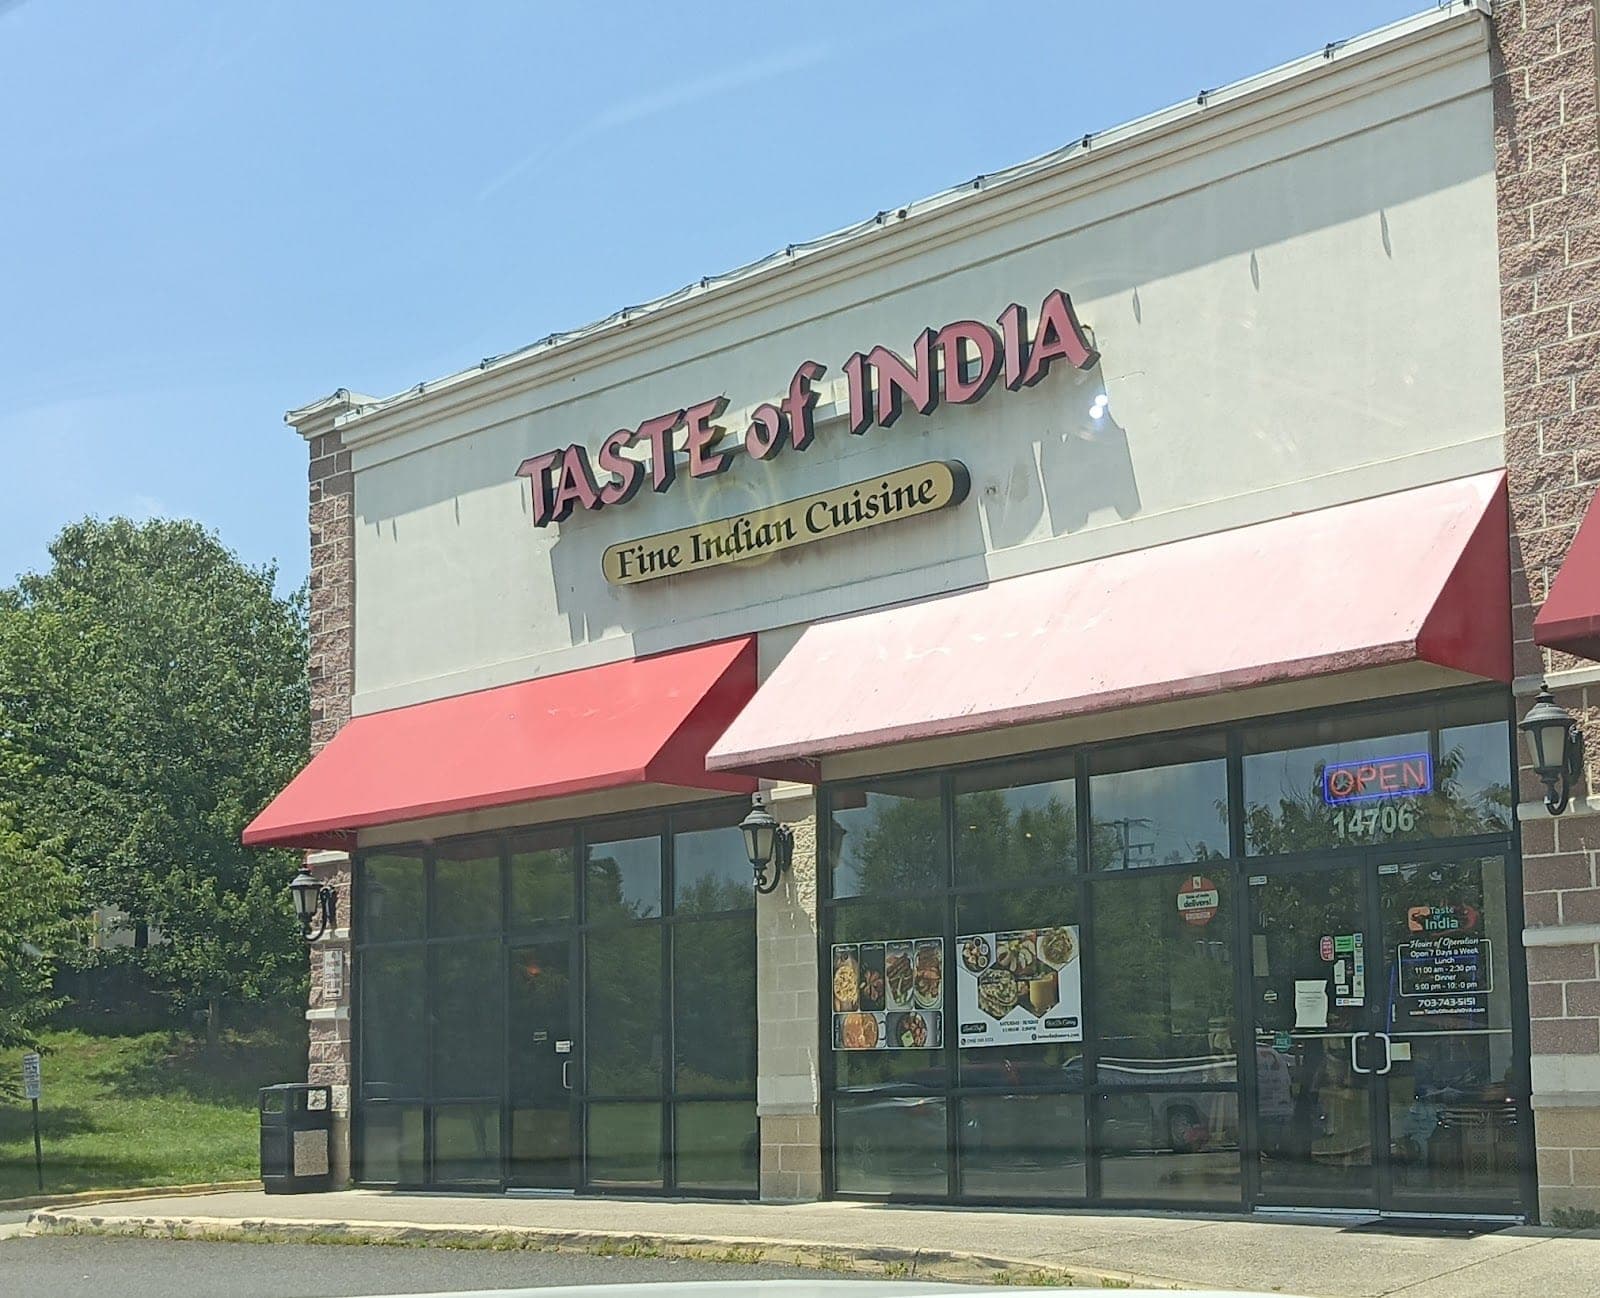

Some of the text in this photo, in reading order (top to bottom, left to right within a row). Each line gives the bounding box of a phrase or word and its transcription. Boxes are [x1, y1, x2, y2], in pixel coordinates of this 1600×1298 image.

[515, 289, 1101, 528] TASTE of INDIA
[617, 477, 938, 579] Fine Indian Cuisine
[1330, 759, 1427, 798] OPEN
[1333, 804, 1414, 838] 14706
[1430, 906, 1454, 914] Taste
[1425, 918, 1459, 930] India
[1409, 937, 1478, 949] Hours of Operation
[1410, 951, 1429, 959] Open
[1436, 949, 1452, 958] Days
[1434, 957, 1455, 965] Lunch
[1465, 965, 1477, 973] pm
[1431, 983, 1441, 991] pm
[1447, 981, 1465, 989] 10:0
[1466, 981, 1477, 989] pm
[1418, 998, 1476, 1008] 703-743-5151
